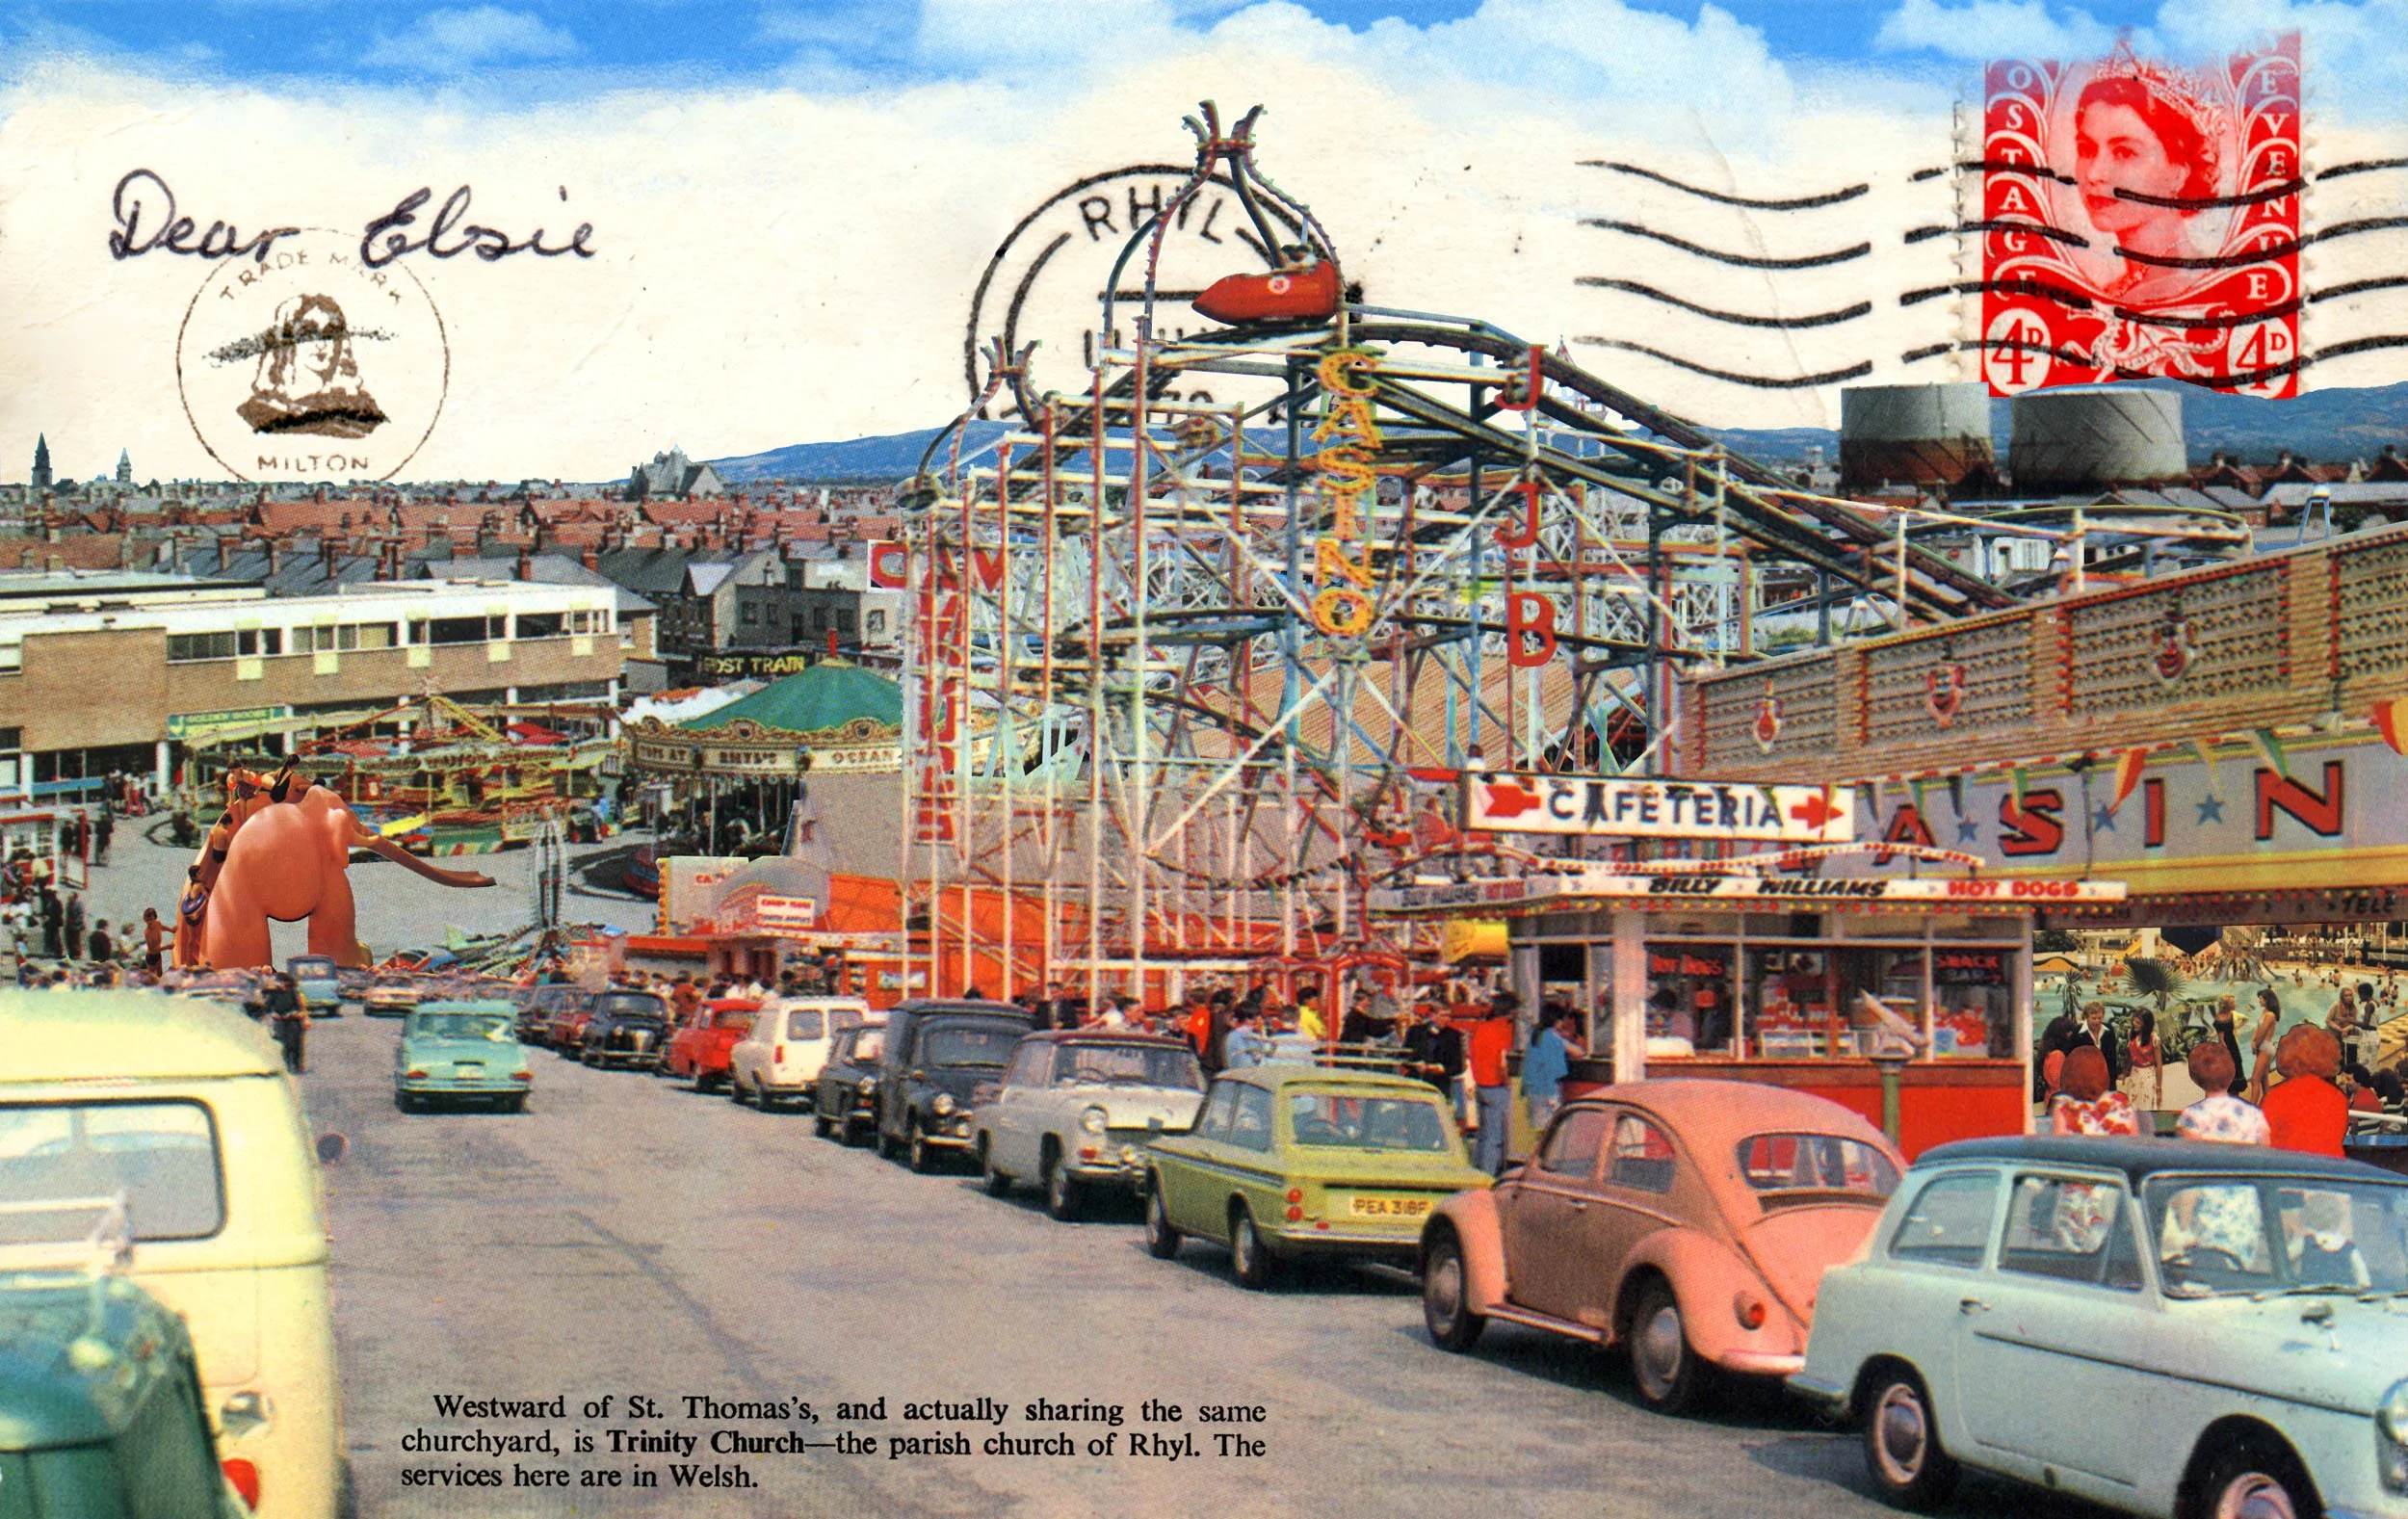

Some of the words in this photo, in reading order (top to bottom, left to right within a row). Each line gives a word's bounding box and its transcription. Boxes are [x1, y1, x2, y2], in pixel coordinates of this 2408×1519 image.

[109, 169, 301, 261] Dear
[360, 184, 597, 269] Elsie
[1078, 184, 1224, 244] RHYL
[219, 249, 310, 301] TRADE
[257, 453, 370, 474] MILTON
[1311, 352, 1383, 637] CASINO
[831, 749, 893, 764] OCEAN
[1778, 760, 2344, 872] ASIN
[1647, 877, 1722, 895] BILLY
[1756, 877, 1889, 898] WILLIAMS
[1948, 880, 2001, 897] HOT
[2011, 879, 2081, 898] DOGS
